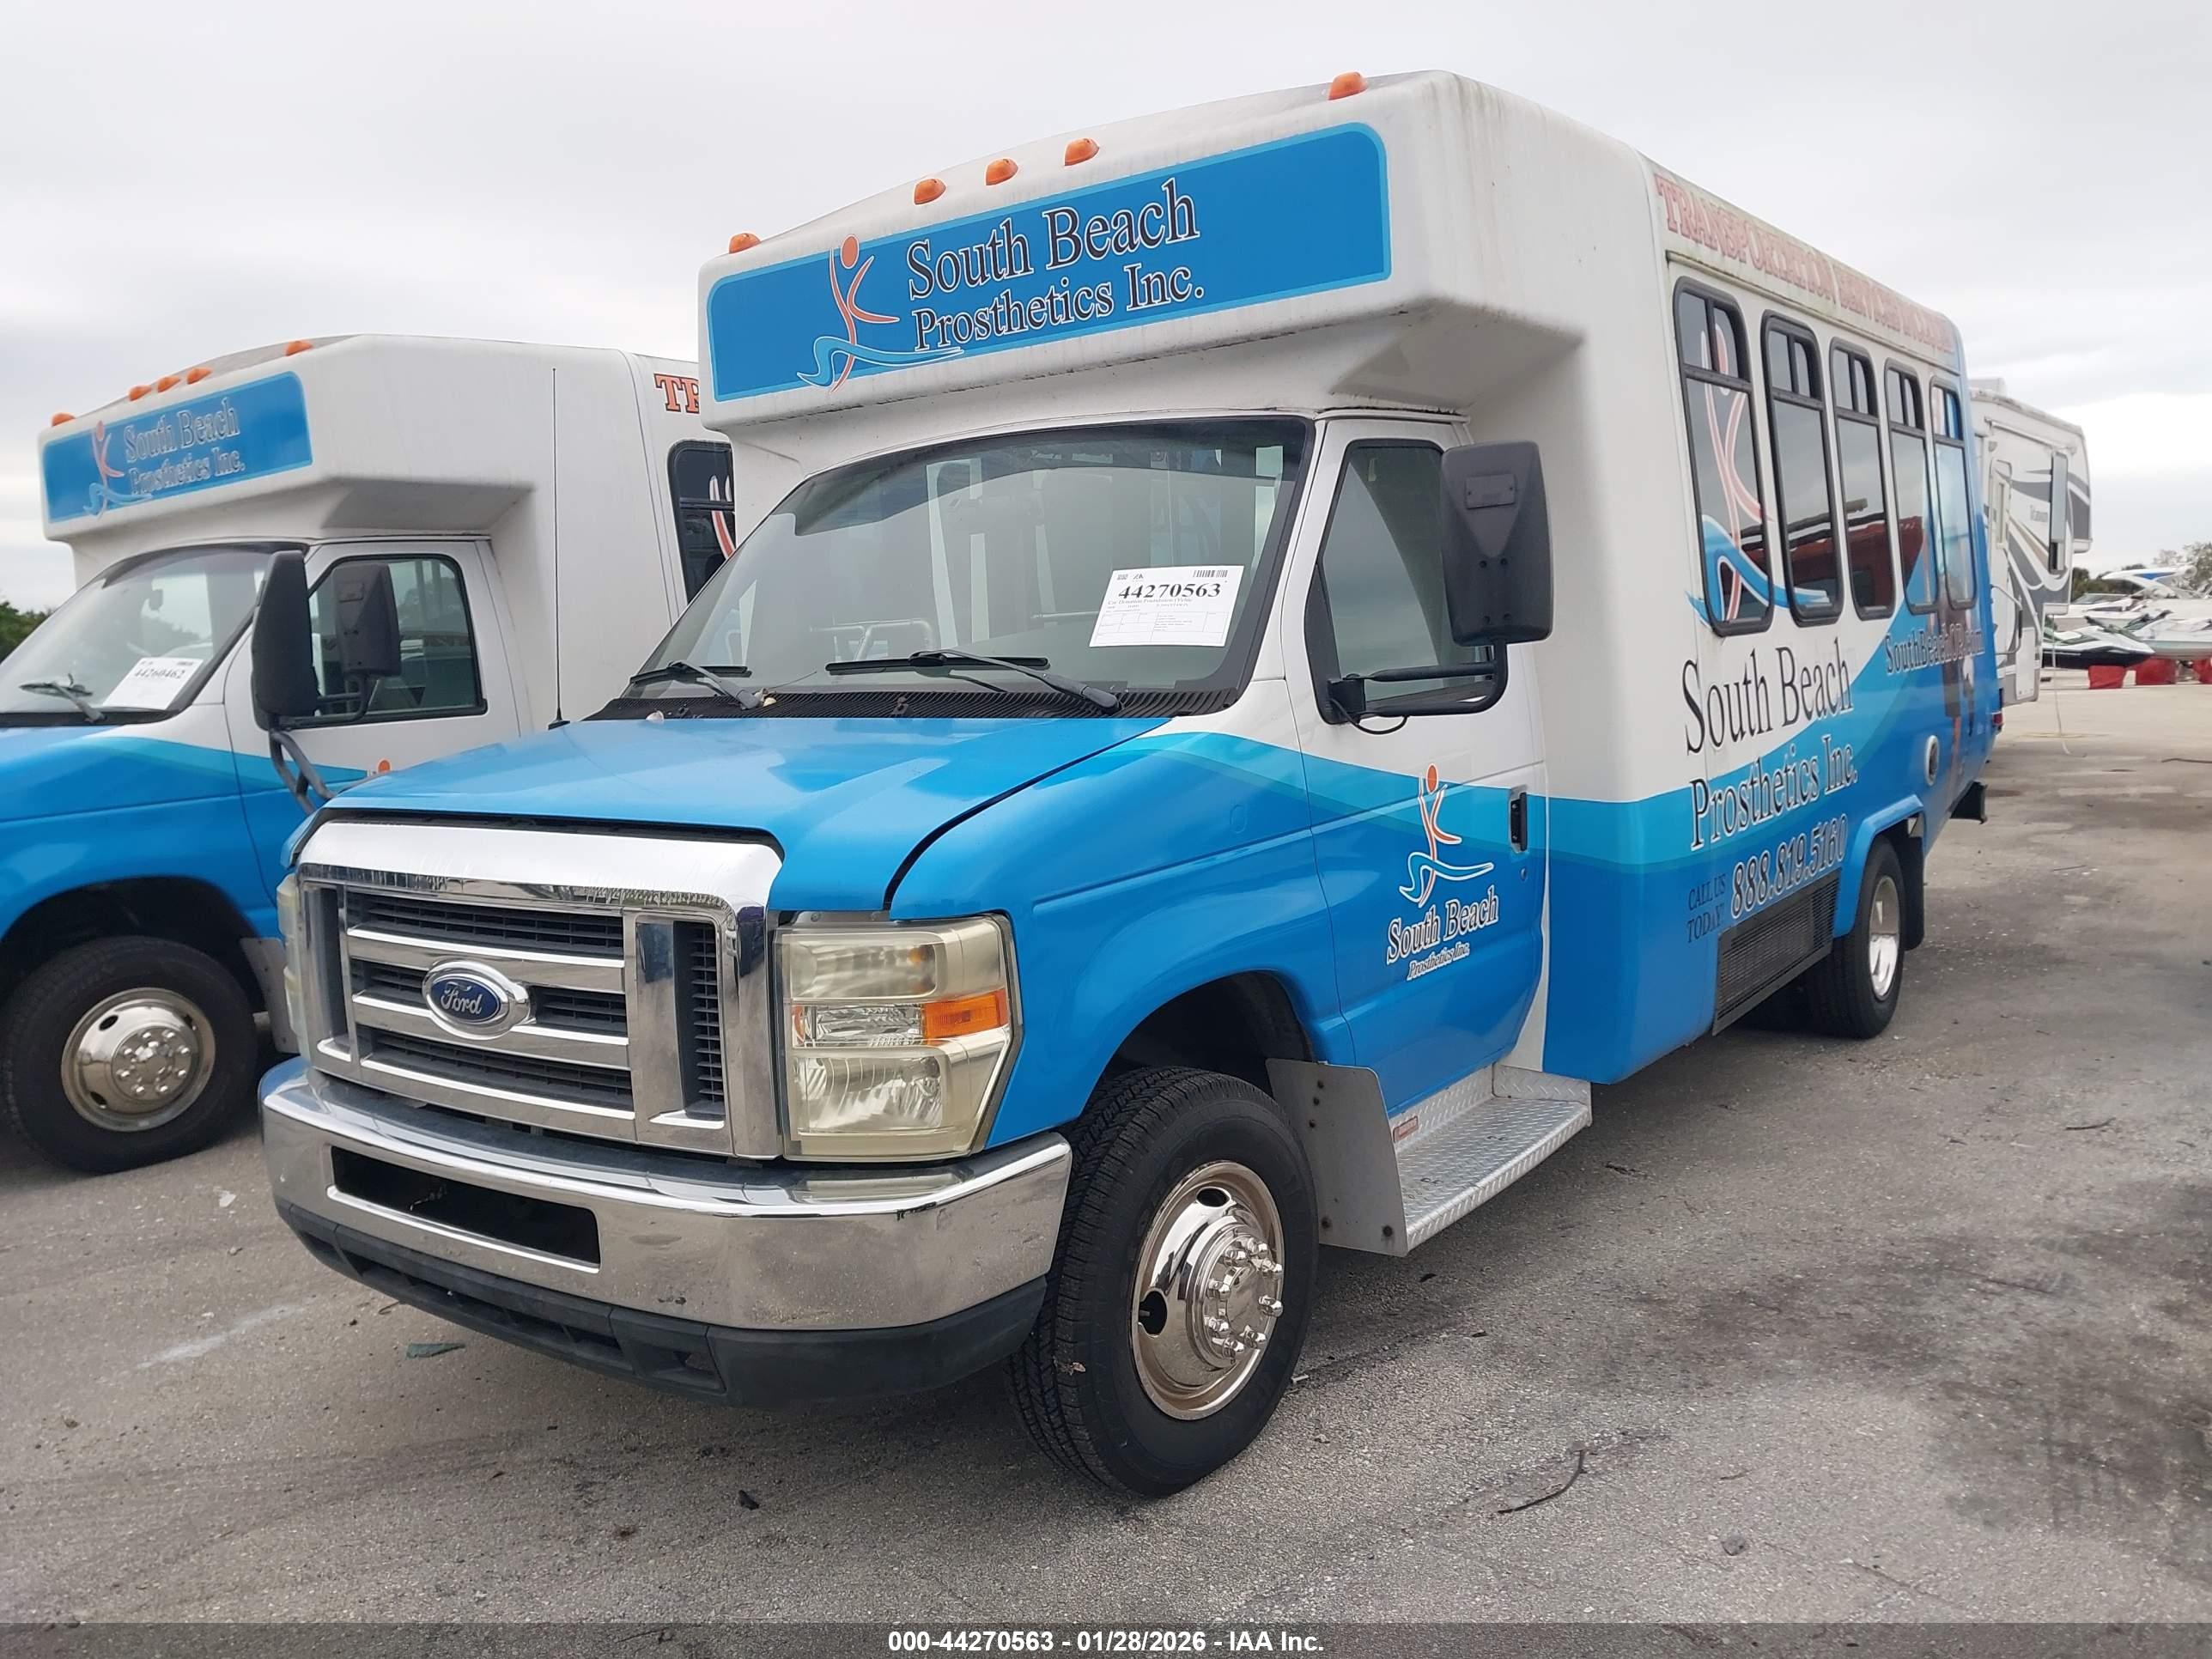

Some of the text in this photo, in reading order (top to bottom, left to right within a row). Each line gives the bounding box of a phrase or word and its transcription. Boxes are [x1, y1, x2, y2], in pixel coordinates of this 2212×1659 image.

[906, 177, 1200, 300] South Beach
[912, 263, 1204, 352] Prosthetics Inc.
[124, 397, 240, 463] South Beach
[129, 447, 246, 495] Prosthetics Inc.
[1118, 583, 1221, 599] 44270563
[1682, 636, 1855, 756] South Beach
[1689, 734, 1858, 852] Prosthetics Inc.
[1688, 873, 1726, 910] CALL US
[1731, 813, 1848, 919] 888.819.5160
[1387, 884, 1498, 964] South Beach
[441, 981, 483, 1014] Ford
[1407, 941, 1470, 981] Prosthetics Inc.
